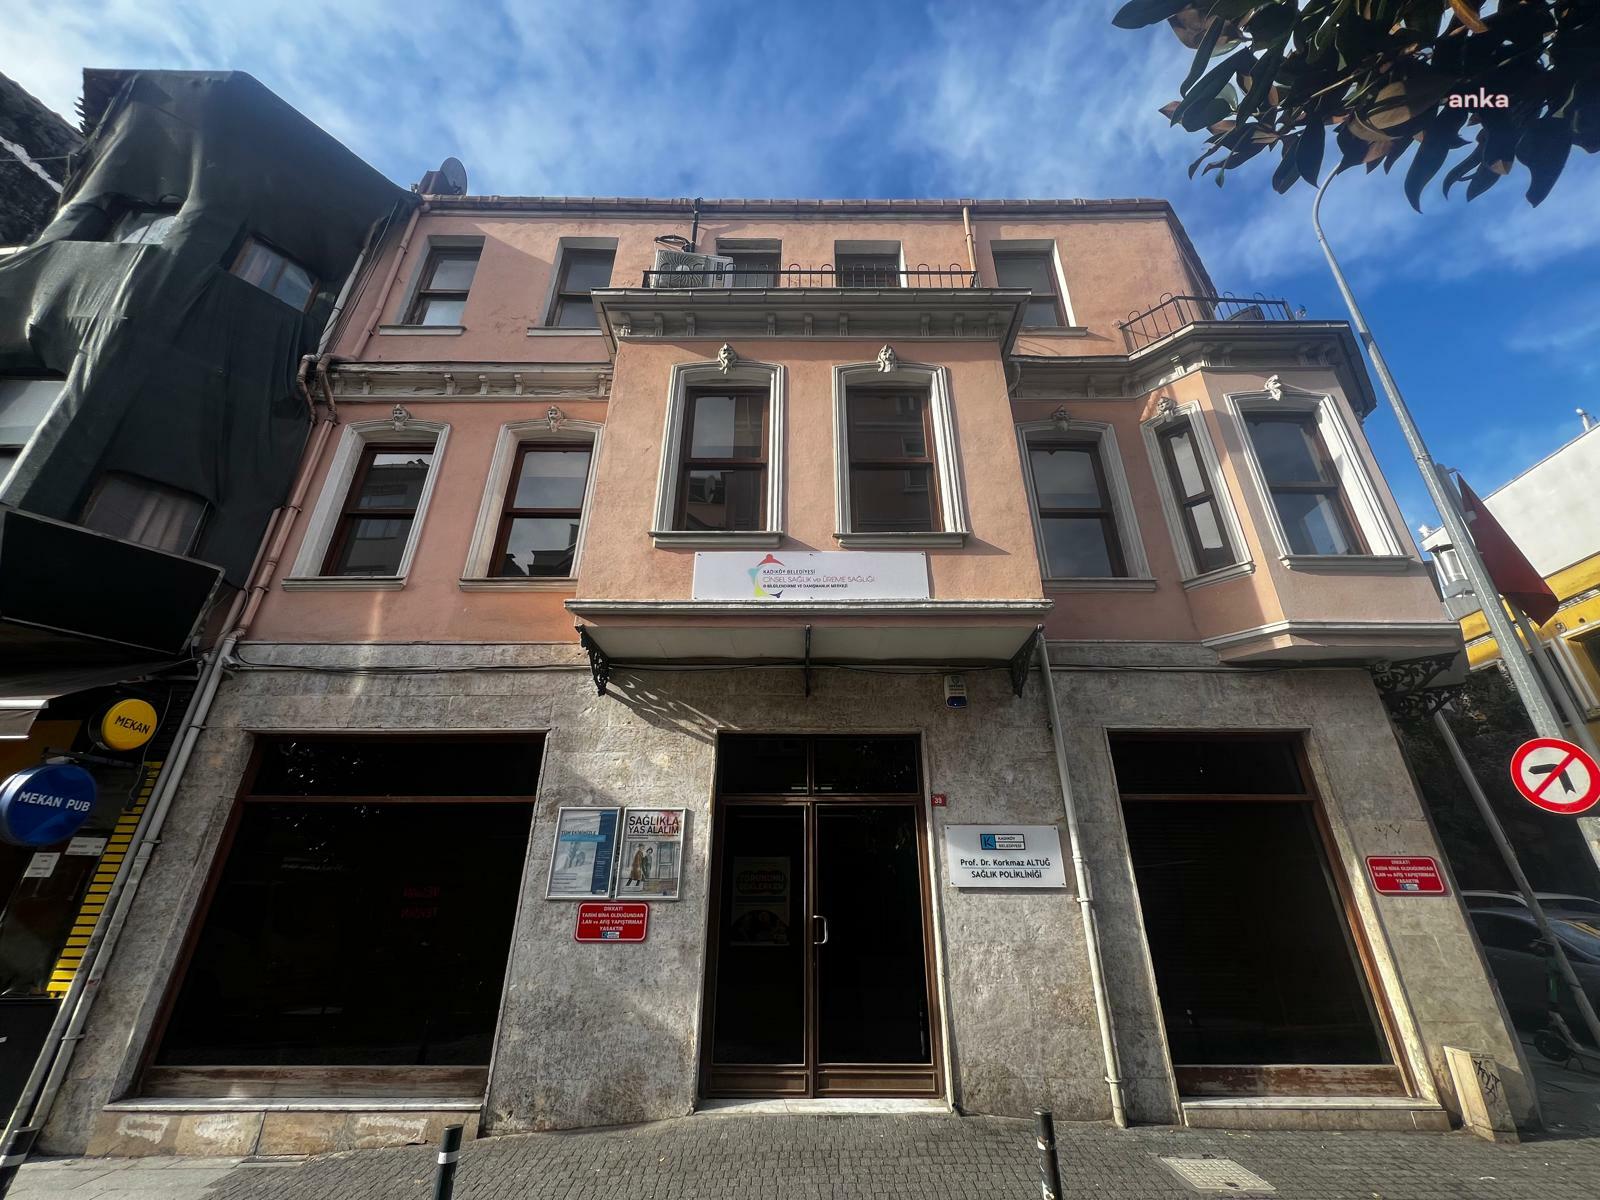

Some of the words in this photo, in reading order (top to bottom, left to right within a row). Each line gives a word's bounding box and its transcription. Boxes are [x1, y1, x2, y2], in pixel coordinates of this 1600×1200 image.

[115, 715, 150, 734] MEKAN
[18, 791, 63, 808] MEKAN
[66, 799, 90, 812] PUB
[629, 814, 679, 826] SAĞLIKLA
[1027, 858, 1050, 866] ALTUĞ
[972, 870, 998, 878] SAĞLIK
[1000, 870, 1042, 878] POLİKLİNİĞİ
